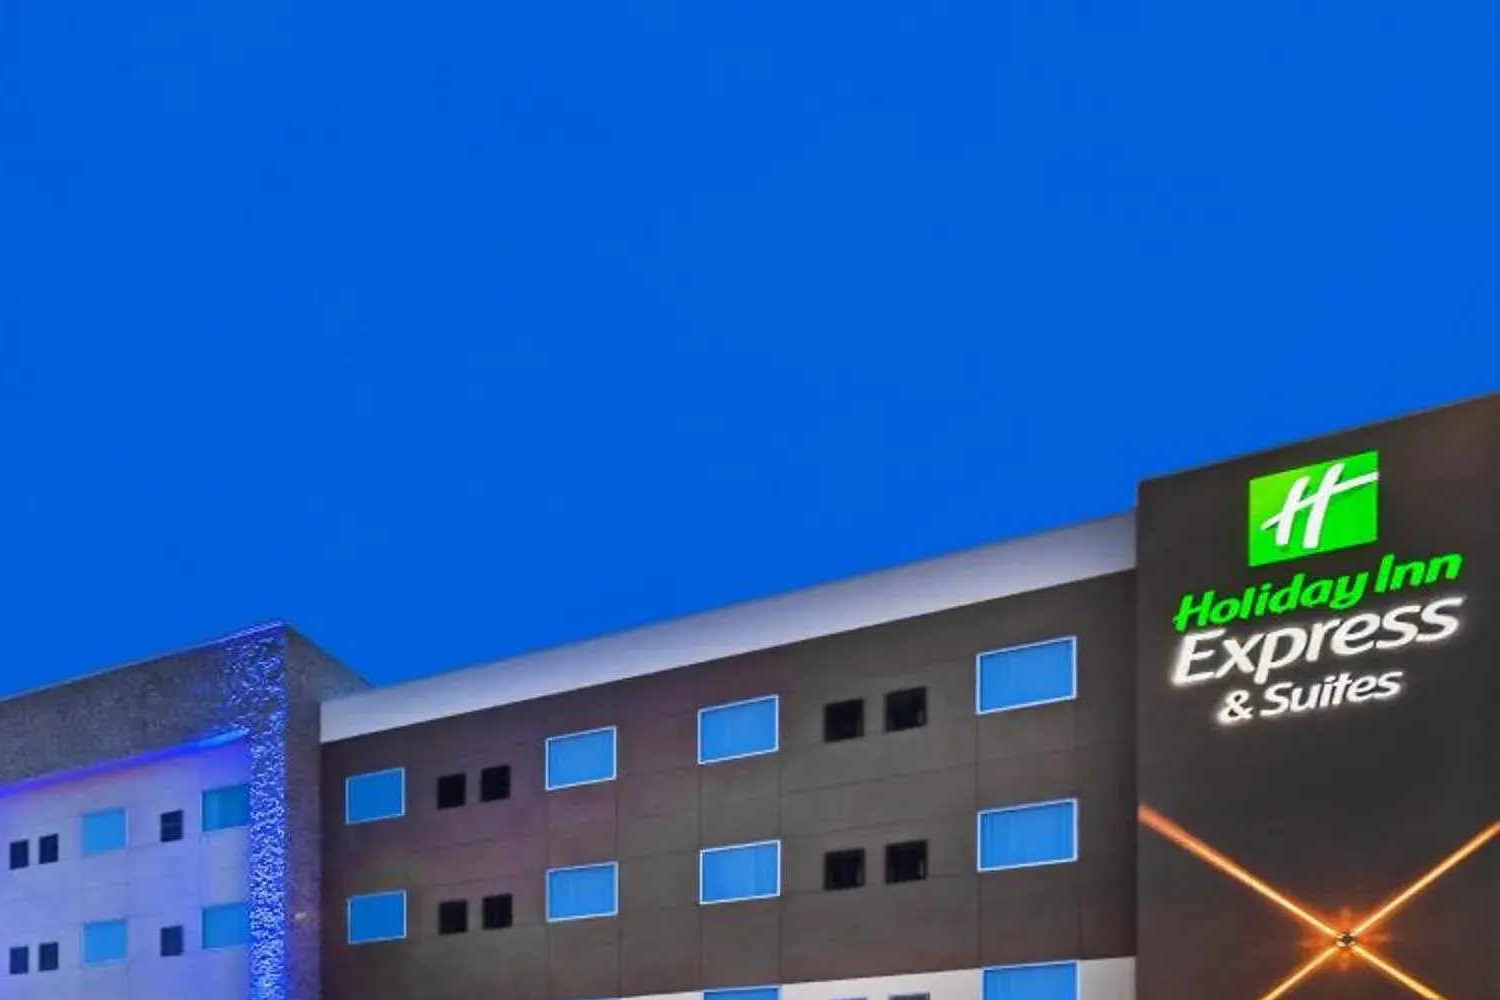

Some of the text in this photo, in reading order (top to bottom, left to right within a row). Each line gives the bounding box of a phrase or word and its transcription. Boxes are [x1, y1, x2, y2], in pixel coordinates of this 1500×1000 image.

[1172, 553, 1463, 632] Holiday Inn
[1170, 596, 1467, 687] Express
[1215, 671, 1404, 725] & Suites
